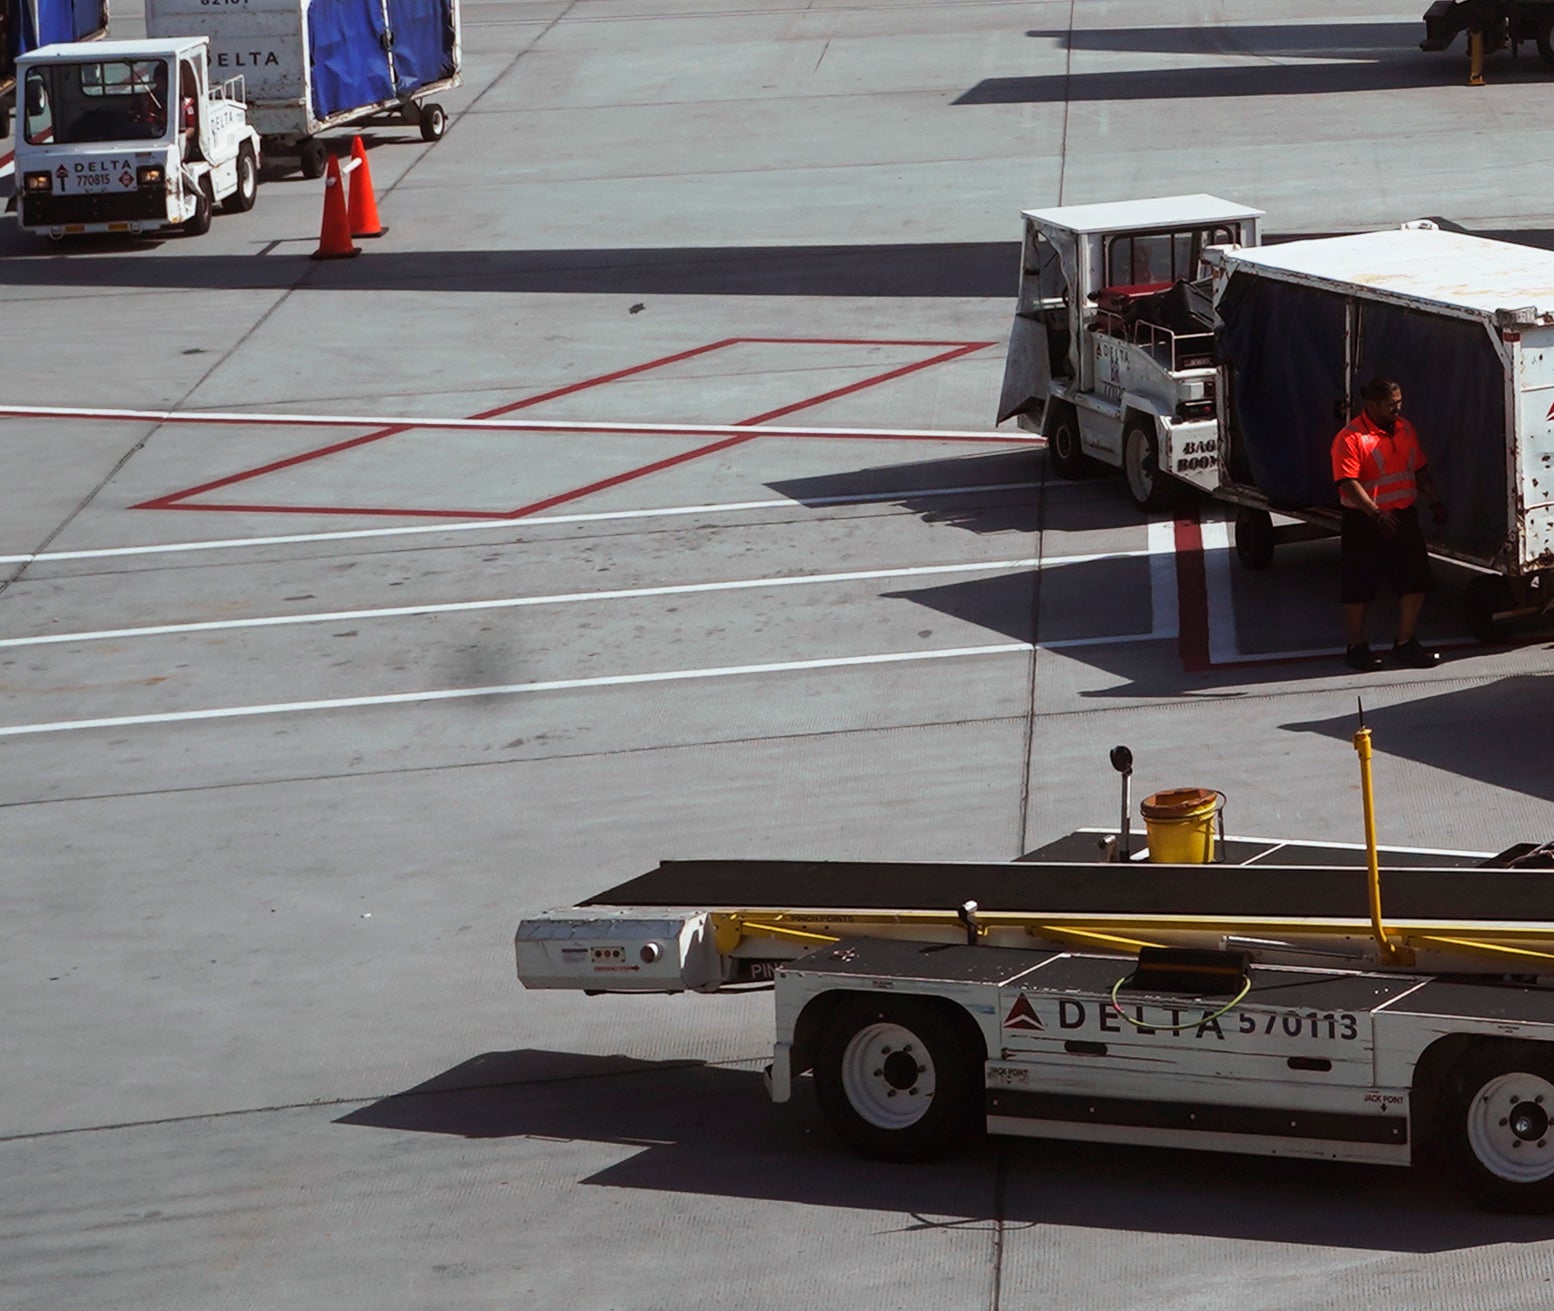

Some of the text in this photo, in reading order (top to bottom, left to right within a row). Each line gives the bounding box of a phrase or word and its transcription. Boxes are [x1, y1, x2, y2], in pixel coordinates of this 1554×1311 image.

[75, 160, 132, 172] DELTA
[1059, 998, 1358, 1041] DELTA 570113
[1382, 1095, 1404, 1105] POINT
